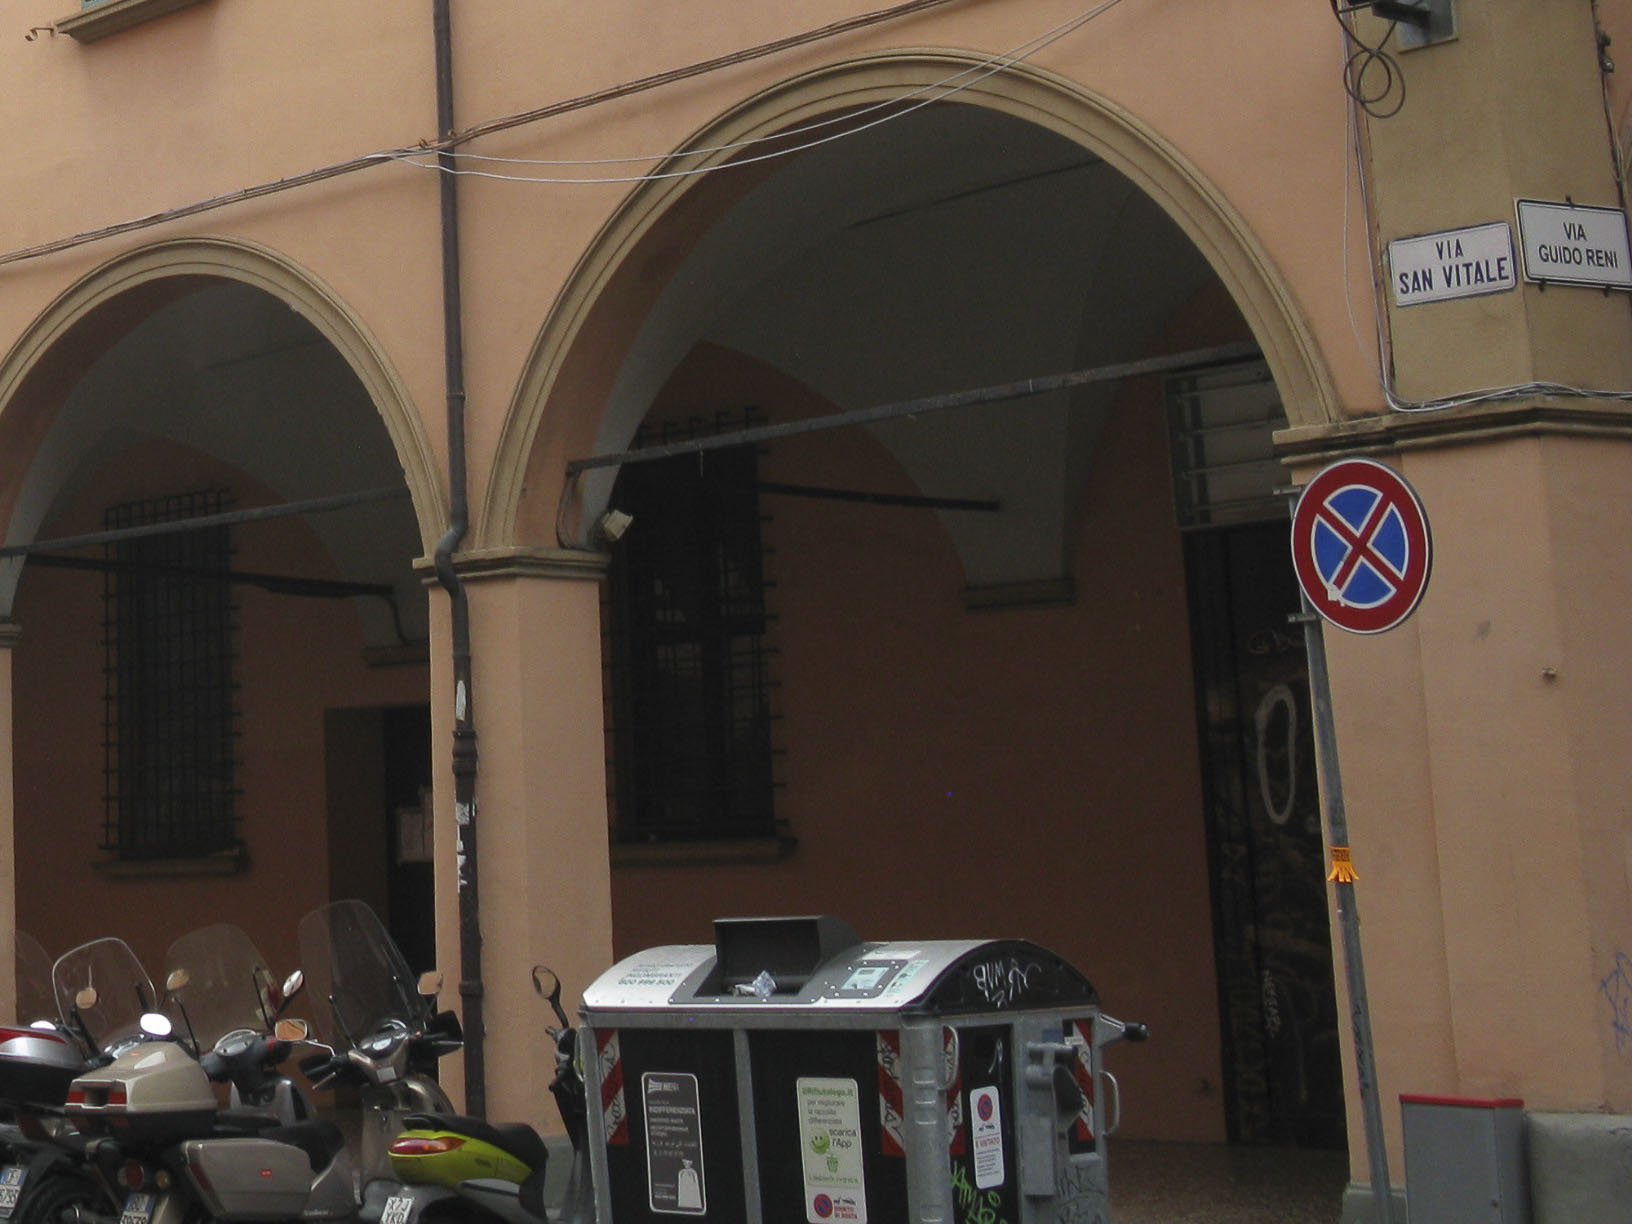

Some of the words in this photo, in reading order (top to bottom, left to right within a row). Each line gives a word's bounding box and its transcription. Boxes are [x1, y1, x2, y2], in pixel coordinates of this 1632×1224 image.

[1563, 222, 1587, 241] VIA
[1435, 239, 1464, 260] VIA
[1538, 244, 1583, 266] GUIDO
[1586, 247, 1618, 269] RENI
[1399, 268, 1433, 295] SAN
[1442, 257, 1510, 288] VITALE
[829, 1128, 857, 1137] scarica
